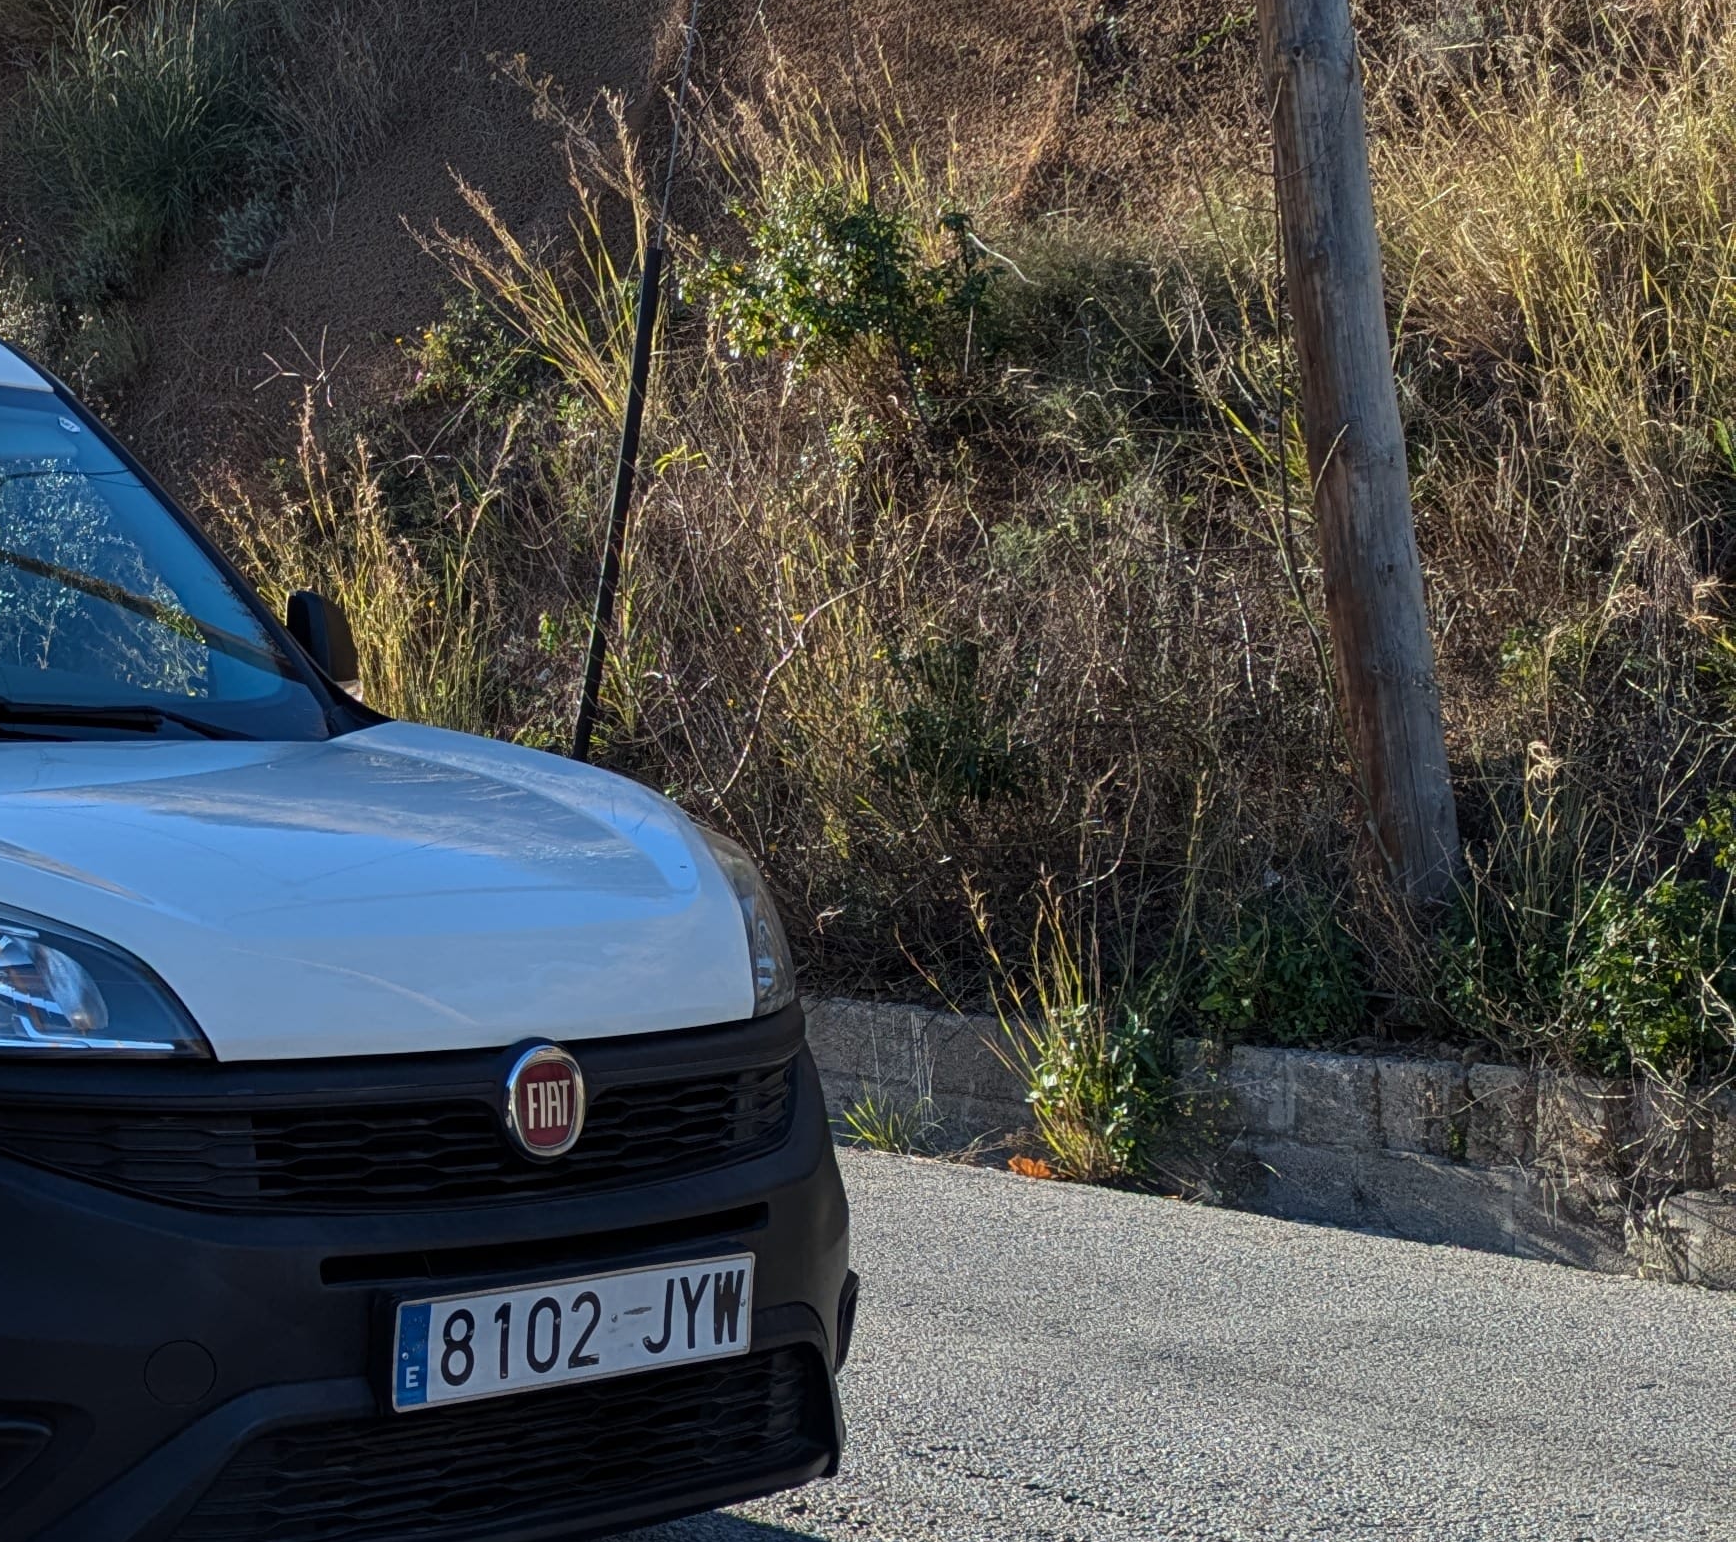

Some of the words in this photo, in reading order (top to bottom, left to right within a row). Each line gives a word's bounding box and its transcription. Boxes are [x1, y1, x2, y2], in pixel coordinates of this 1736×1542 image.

[527, 1079, 571, 1130] FIAT
[405, 1366, 420, 1389] E
[440, 1291, 602, 1387] 8102
[642, 1269, 745, 1354] JYW
